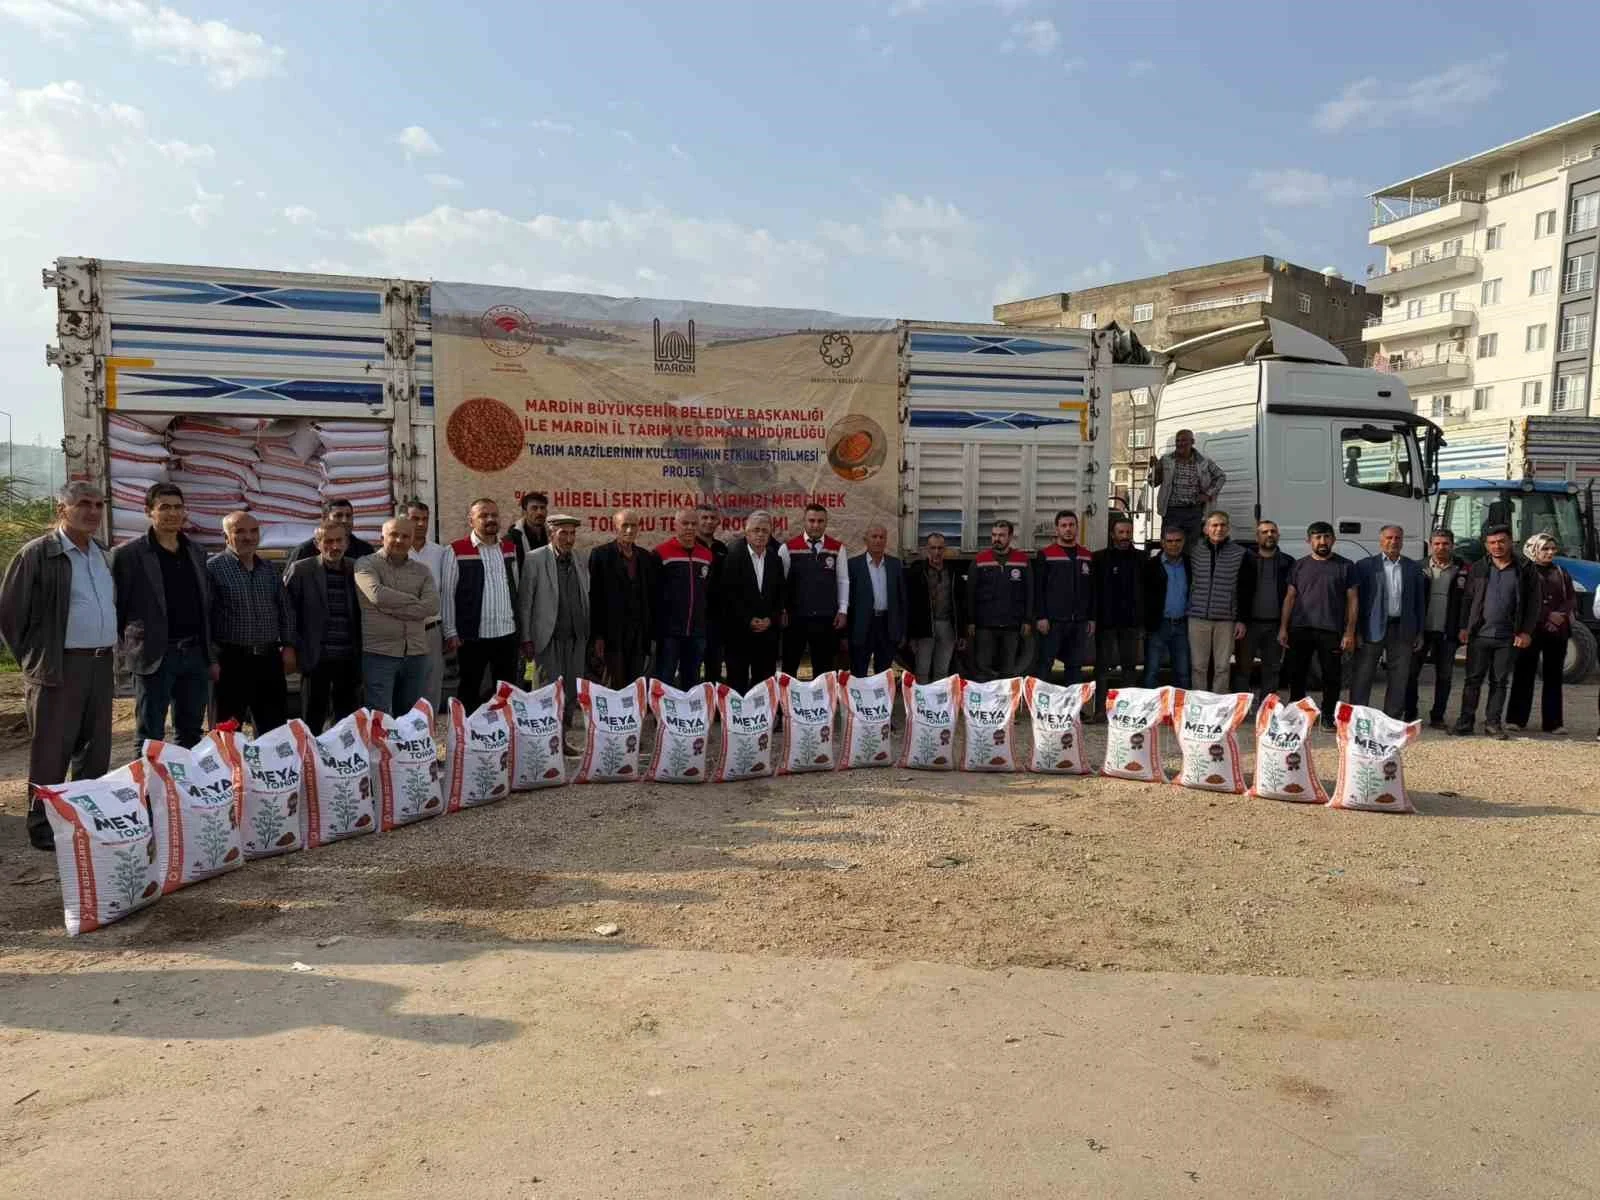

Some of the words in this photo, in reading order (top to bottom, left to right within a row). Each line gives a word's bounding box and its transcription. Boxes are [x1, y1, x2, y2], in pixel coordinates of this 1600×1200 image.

[525, 398, 583, 415] MARDİN
[587, 399, 677, 418] BÜYÜKŞEHİR
[681, 405, 745, 421] BELEDİYE
[747, 408, 824, 423] BAŞKANLIĞI
[524, 416, 548, 432] İLE
[551, 418, 609, 435] MARDİN
[612, 420, 625, 436] İL
[628, 423, 673, 437] TARIM
[676, 424, 693, 437] VE
[695, 425, 743, 438] ORMAN
[747, 424, 826, 440] MÜDÜRLÜĞÜ
[553, 487, 607, 508] HİBELİ
[793, 706, 828, 717] MEYA
[855, 703, 889, 716] MEYA
[968, 709, 1005, 721] MEYA
[516, 715, 557, 728] MEYA
[599, 714, 636, 726] MEYA
[666, 715, 705, 728] MEYA
[731, 713, 768, 727] MEYA
[1036, 710, 1074, 723] MEYA
[1112, 713, 1148, 726] MEYA
[1184, 720, 1223, 734] MEYA
[250, 766, 299, 783] MEYA
[187, 778, 233, 797] MEYA
